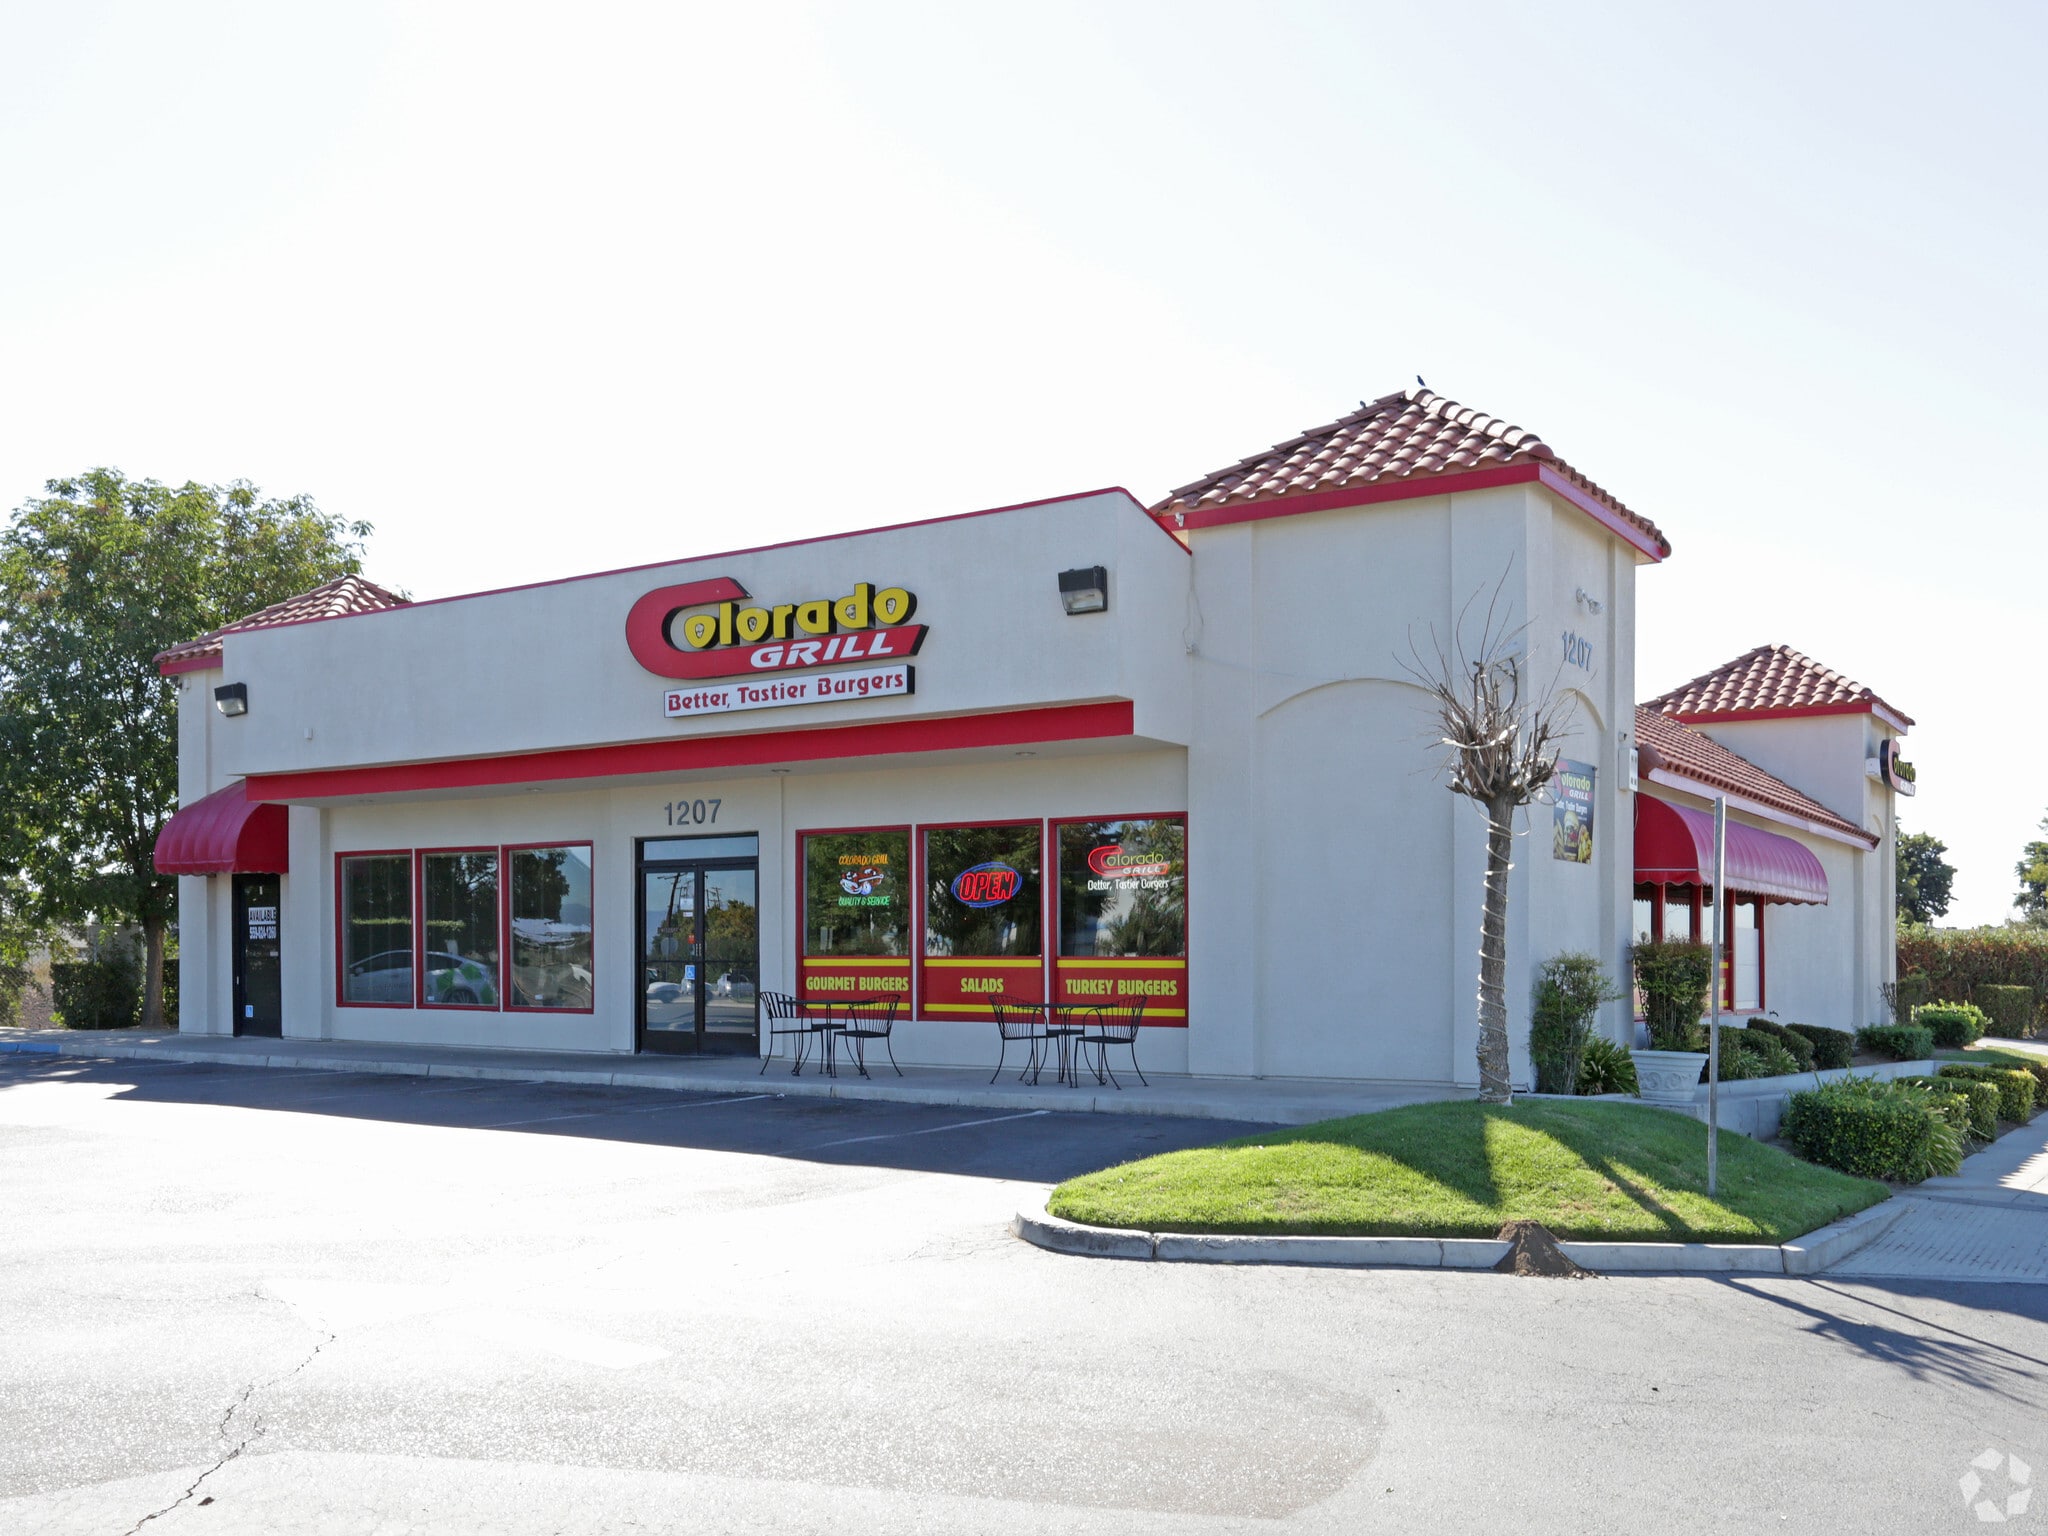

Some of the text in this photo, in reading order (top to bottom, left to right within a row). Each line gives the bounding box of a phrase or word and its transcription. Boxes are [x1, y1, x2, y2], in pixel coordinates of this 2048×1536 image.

[625, 576, 929, 680] Colorado
[750, 632, 896, 668] GRILL
[1562, 631, 1593, 671] 1207
[668, 672, 904, 712] Better, Tastier Burgers
[1569, 789, 1589, 801] GRILL
[664, 799, 721, 826] 1207
[839, 853, 888, 865] COLORADO GRILL
[1088, 845, 1169, 877] Colorado
[1122, 865, 1161, 875] GRILL
[960, 871, 1015, 901] OPEN
[838, 896, 861, 906] QUALITY
[867, 896, 890, 906] SERVICE
[249, 909, 276, 922] AVAILABLE
[806, 975, 909, 992] GOURMET BURGERS
[960, 977, 1004, 993] SALADS
[1066, 979, 1178, 996] TURKEY BURGERS
